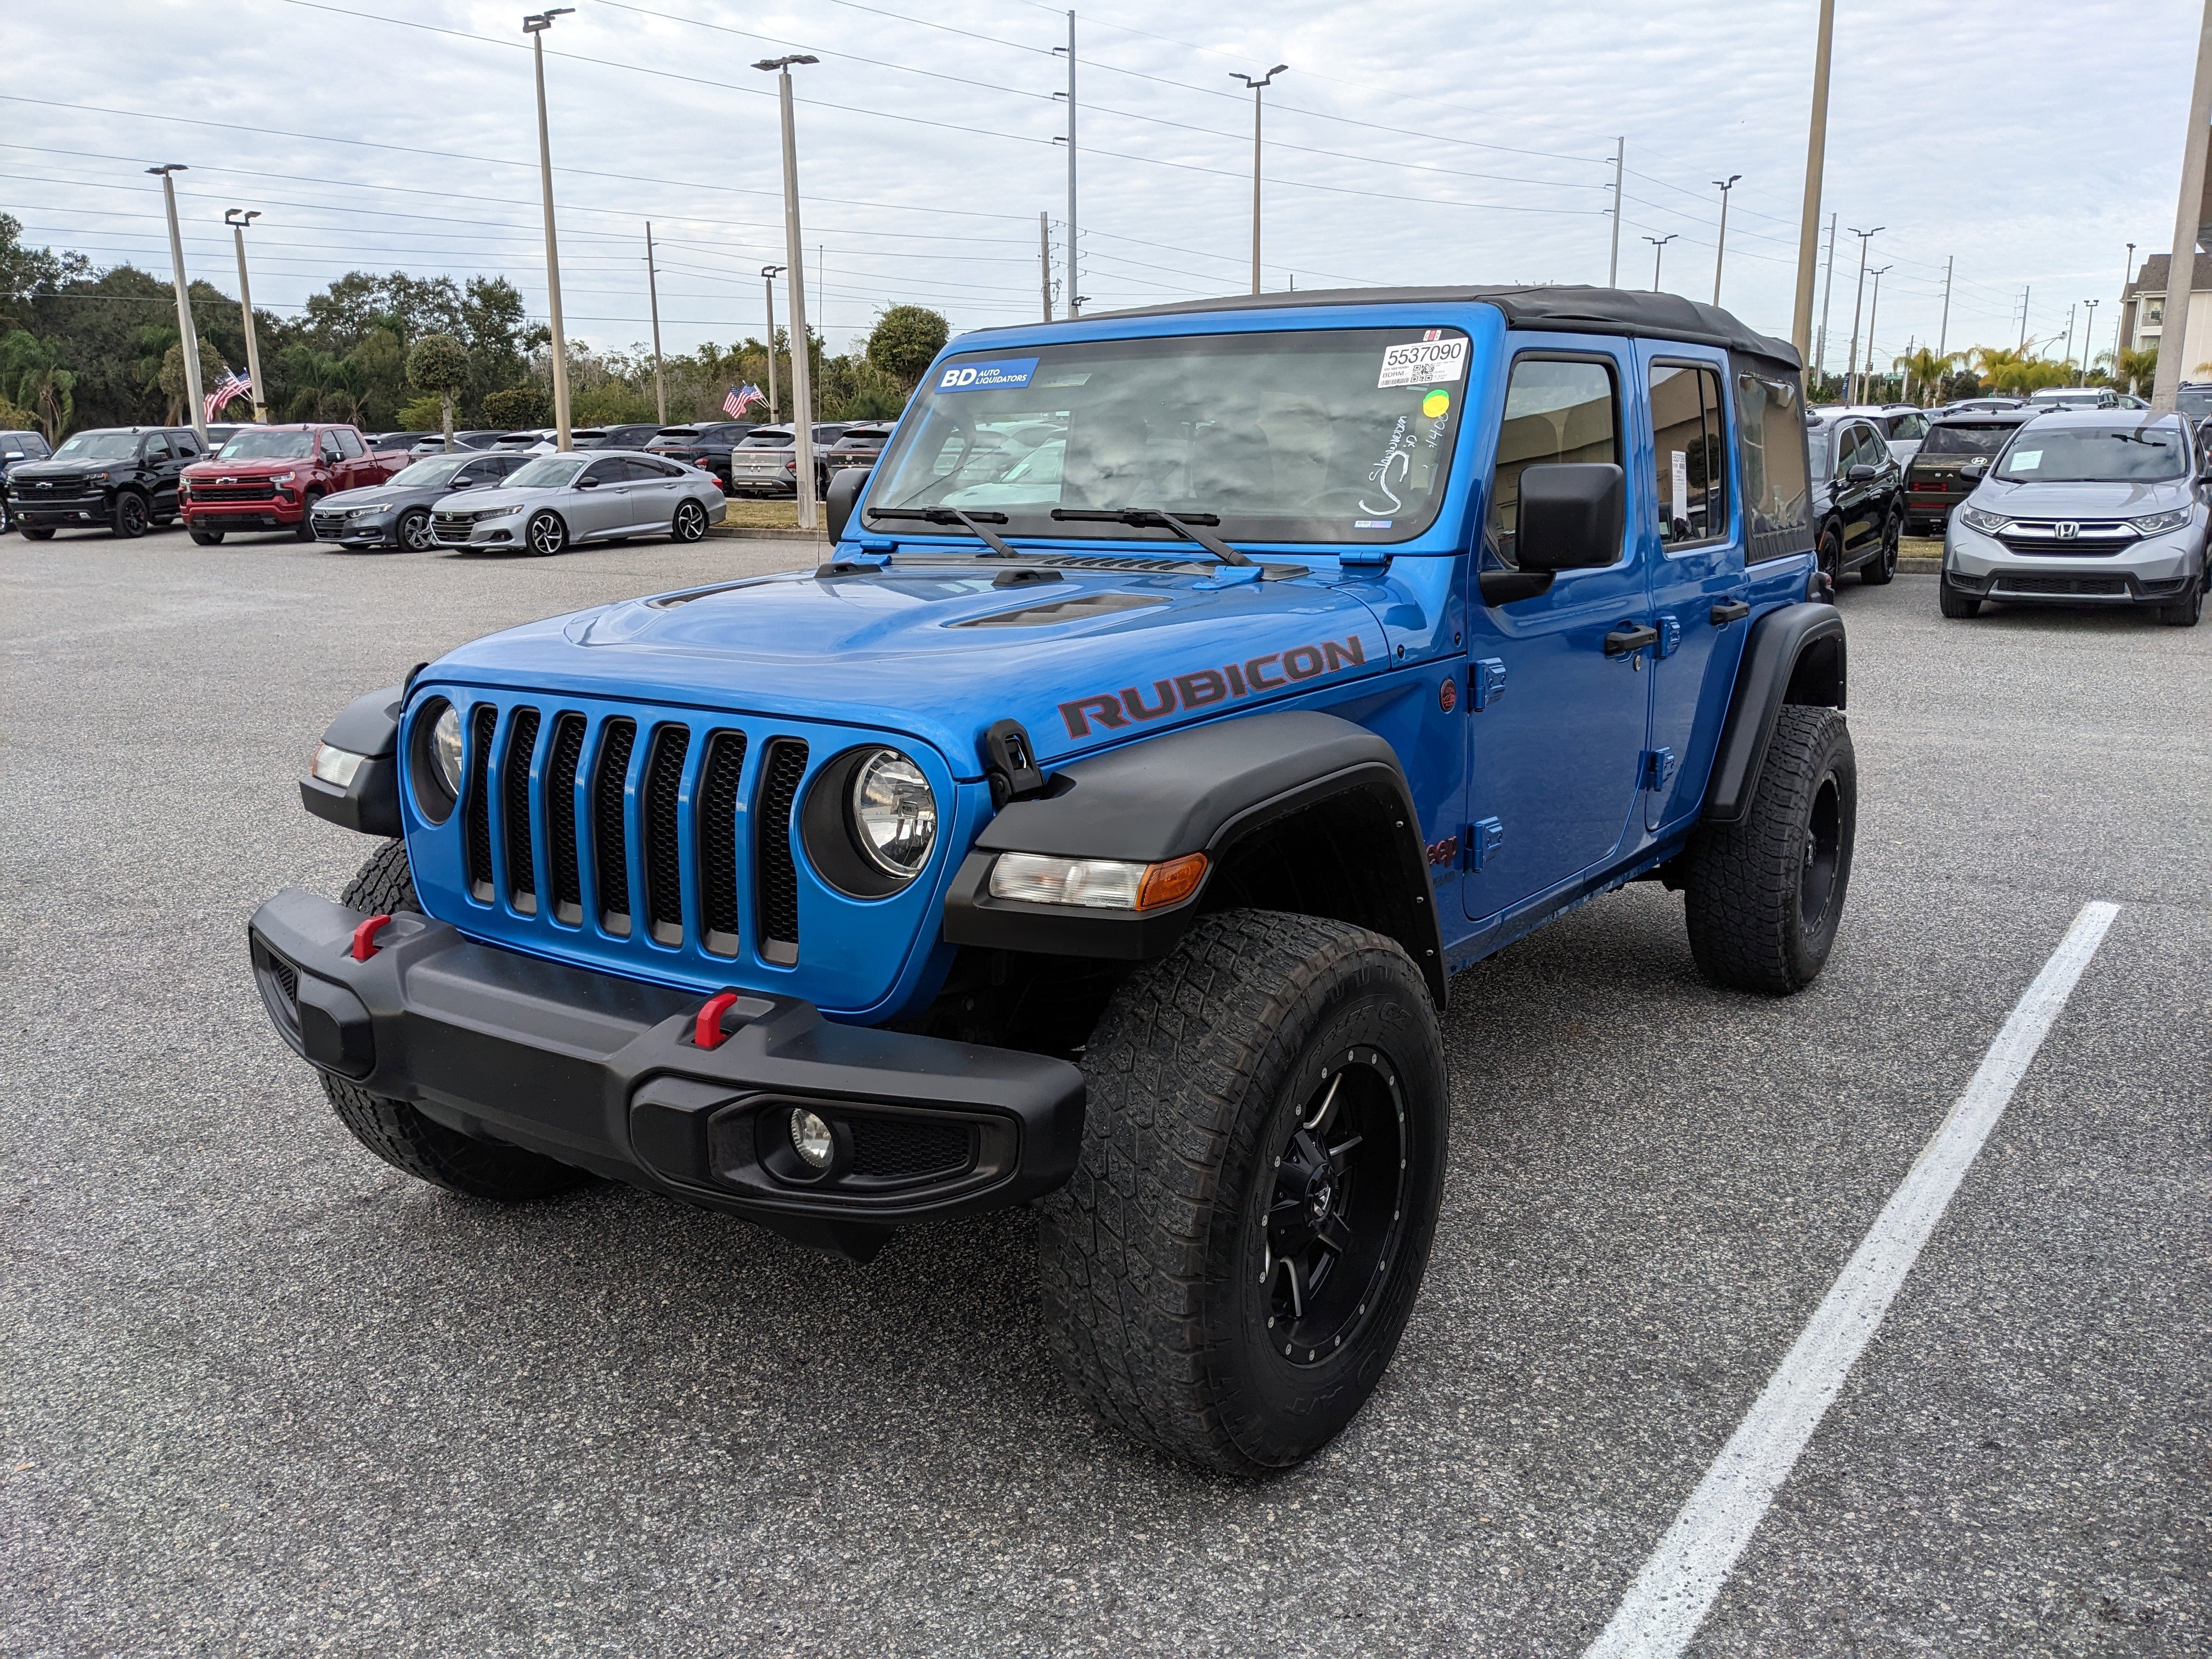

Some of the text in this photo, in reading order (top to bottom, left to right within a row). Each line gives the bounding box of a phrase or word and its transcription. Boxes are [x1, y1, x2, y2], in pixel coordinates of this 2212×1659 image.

[1387, 343, 1462, 366] 5537090
[940, 368, 977, 387] BD
[975, 374, 1028, 385] LIQUIDATORS
[978, 369, 1000, 377] AUTO
[1057, 634, 1367, 740] RUBICON
[1426, 836, 1457, 867] eep
